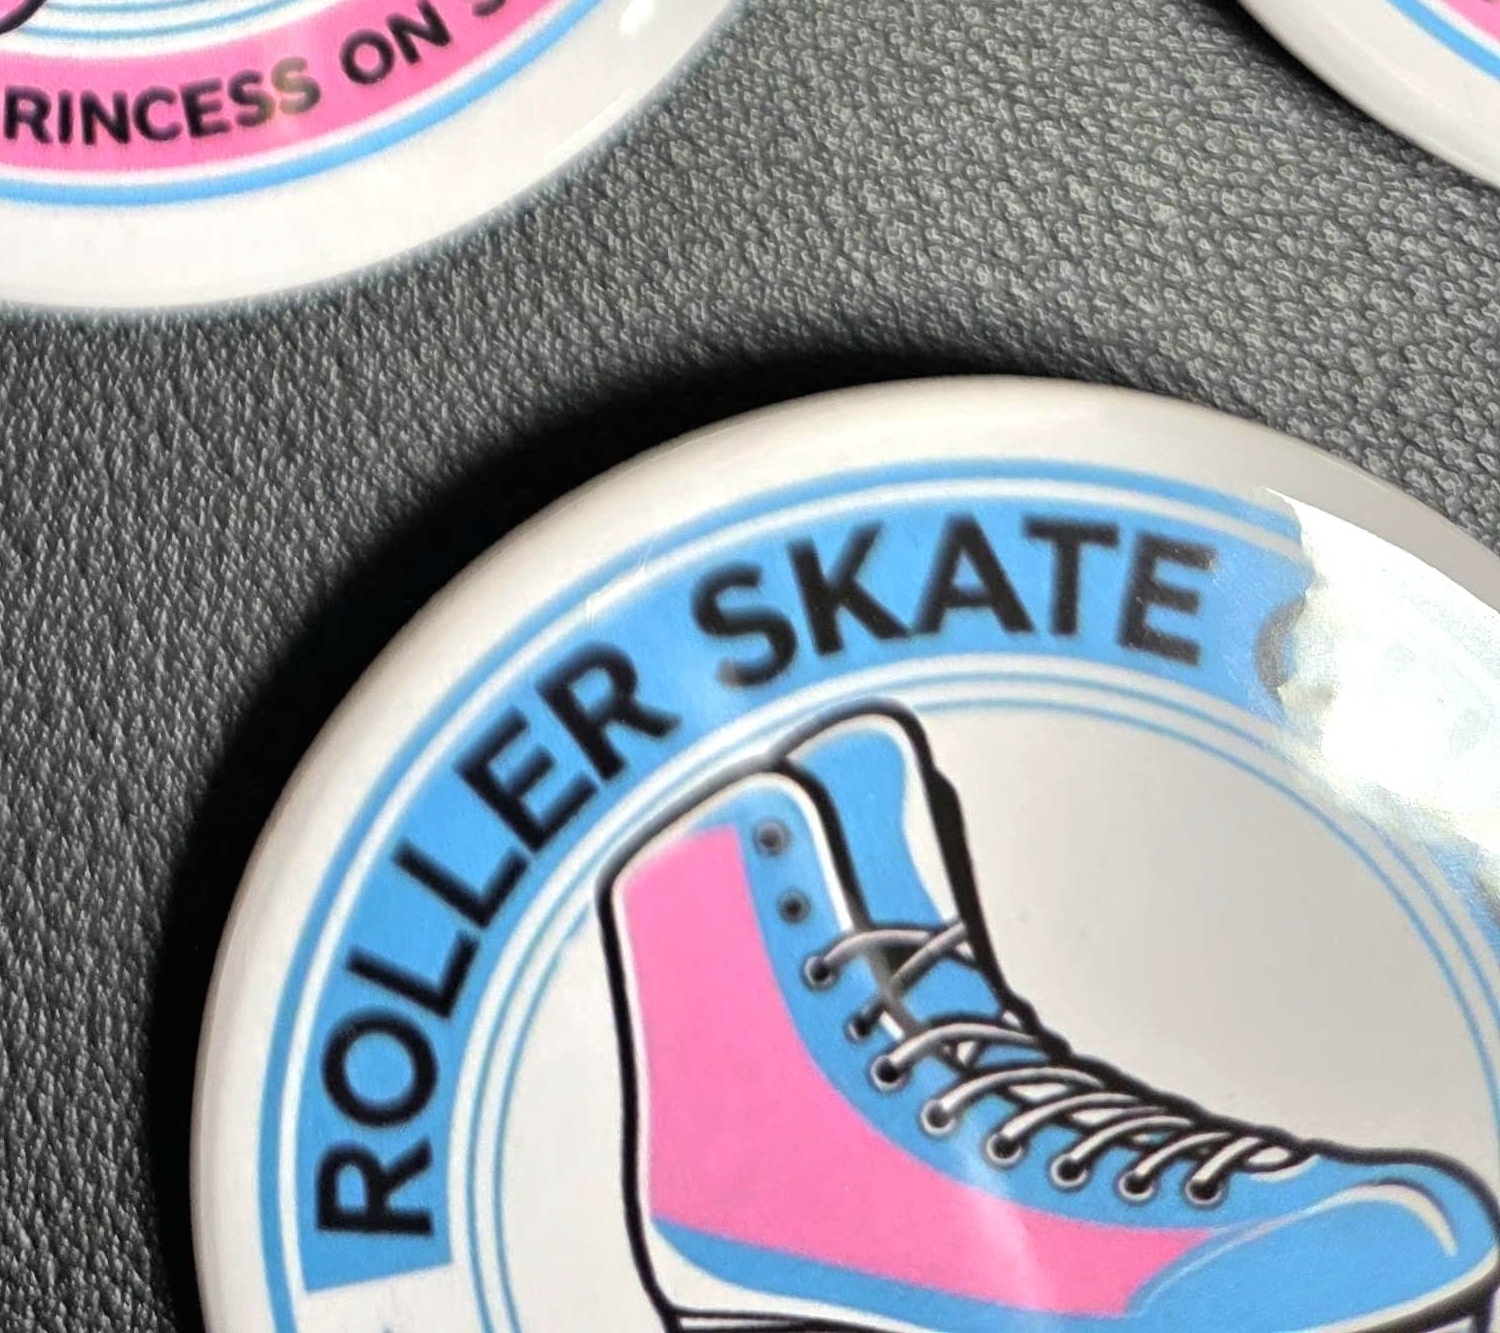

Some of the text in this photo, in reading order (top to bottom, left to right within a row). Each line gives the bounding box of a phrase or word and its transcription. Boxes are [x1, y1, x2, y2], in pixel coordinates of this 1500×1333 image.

[339, 0, 450, 85] ON
[316, 515, 1216, 1238] ROLLER SKATE
